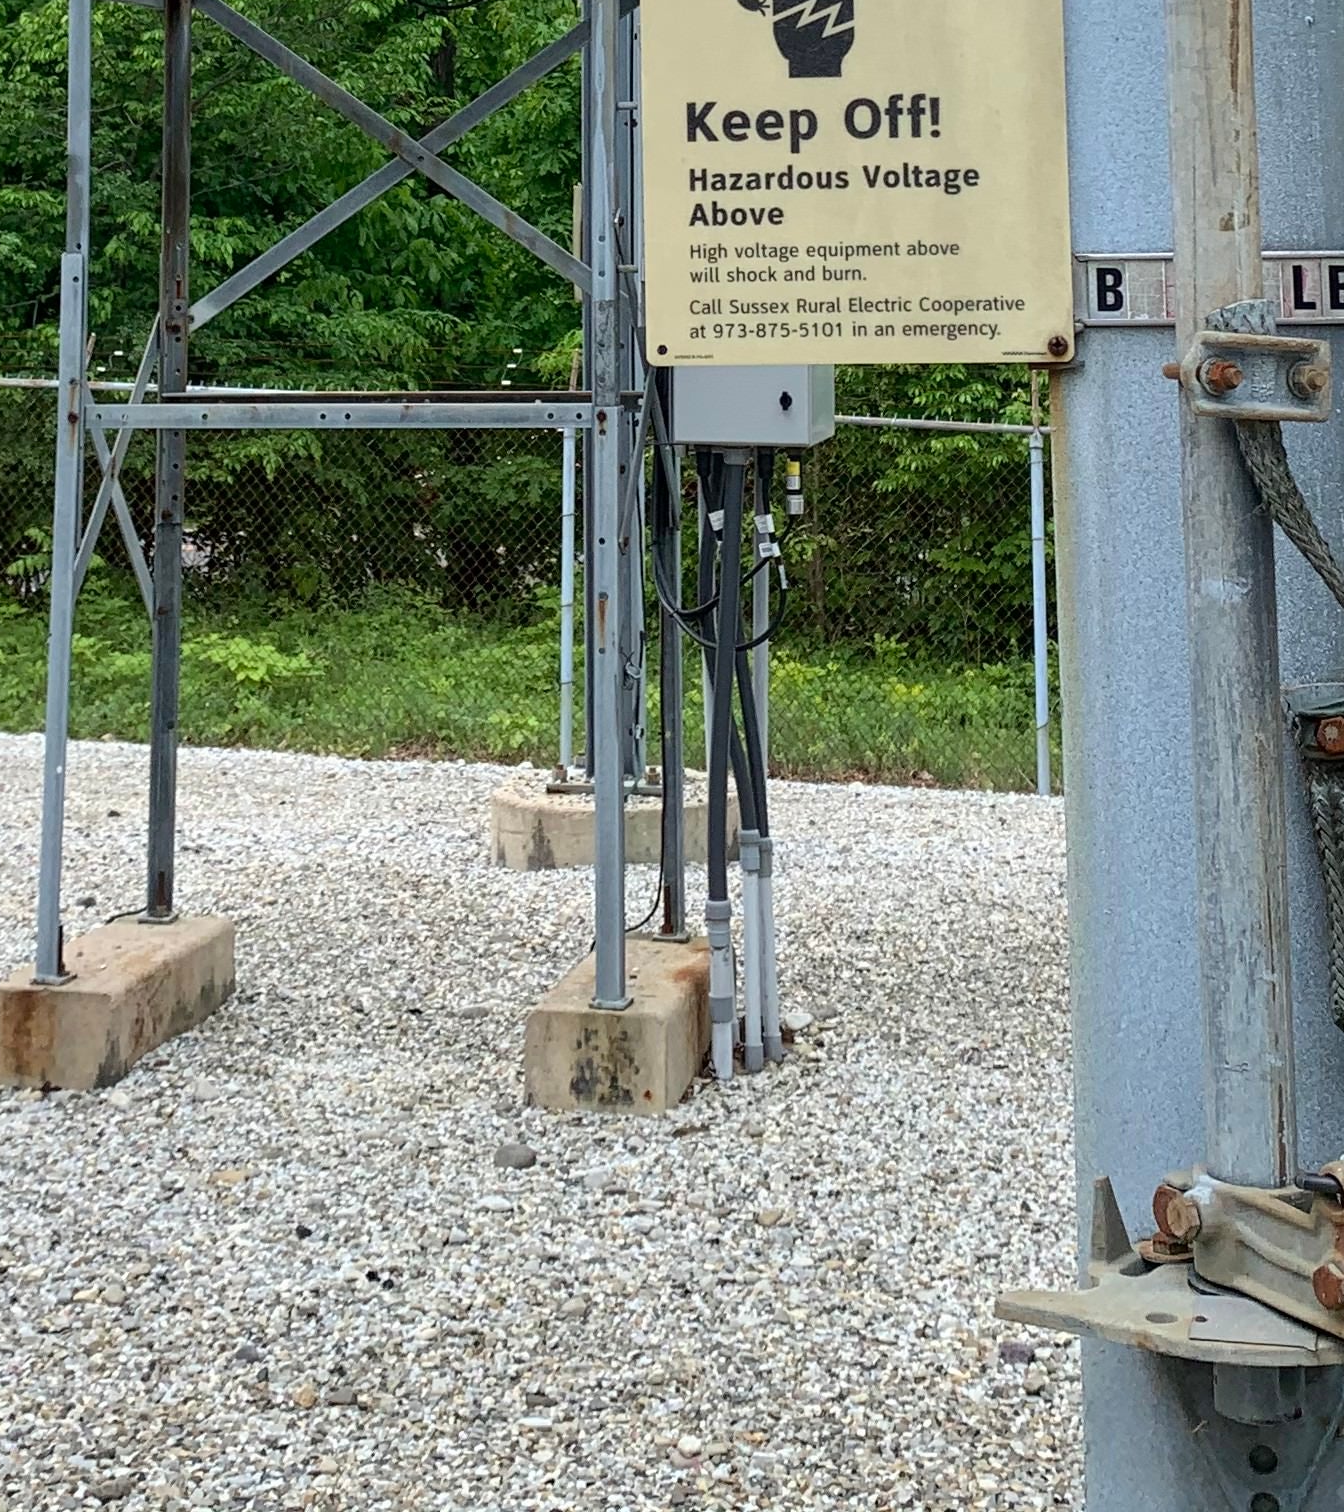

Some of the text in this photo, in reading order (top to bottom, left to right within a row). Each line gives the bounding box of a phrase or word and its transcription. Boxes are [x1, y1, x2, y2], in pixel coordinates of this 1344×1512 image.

[685, 93, 941, 154] Keep Off!
[689, 162, 980, 195] Hazardous Voltage
[689, 201, 785, 227] Above
[690, 240, 960, 263] High voltage equipment above
[689, 265, 867, 283] will shock and burn.
[1096, 267, 1124, 312] B
[689, 296, 1025, 316] Call Sussex Rural Electric Cooperative
[689, 321, 1001, 341] at 973-875-5101 in an emergency.
